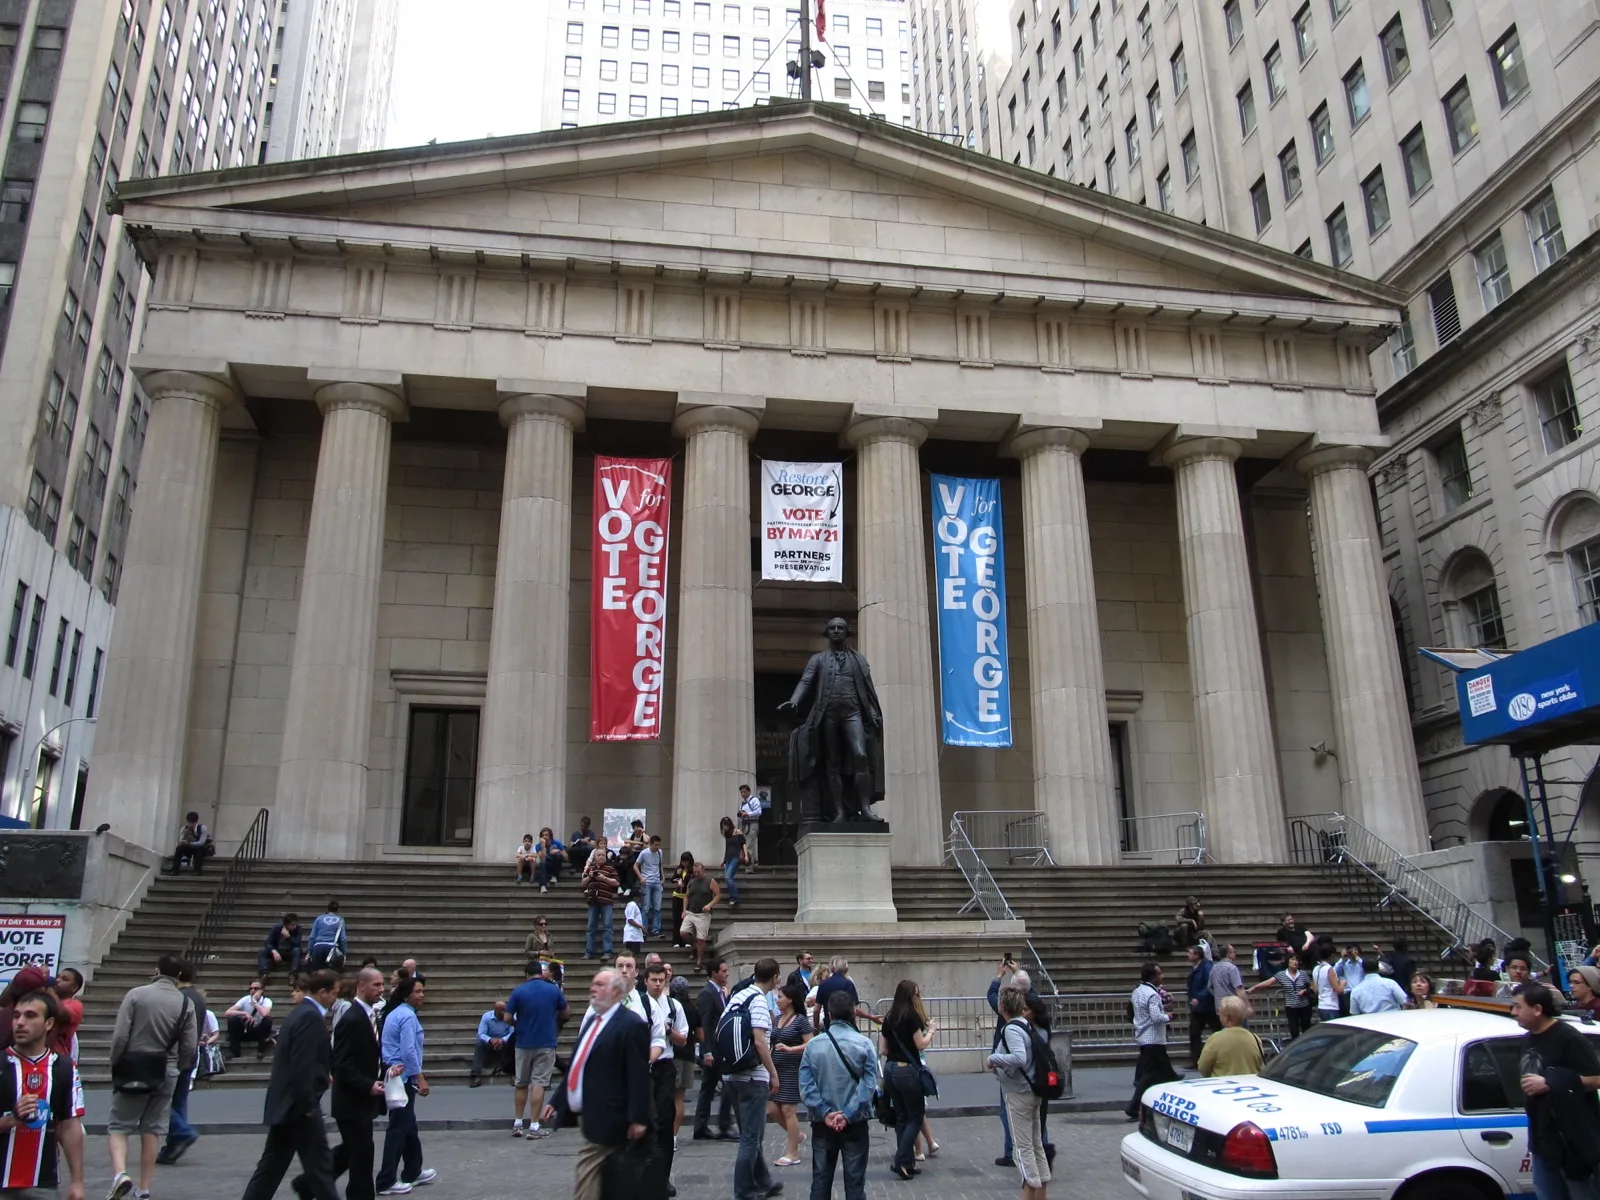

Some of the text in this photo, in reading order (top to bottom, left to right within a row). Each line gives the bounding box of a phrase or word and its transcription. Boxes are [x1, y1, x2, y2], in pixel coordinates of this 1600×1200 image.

[777, 469, 829, 485] Restore
[771, 483, 835, 496] GEORGE
[782, 508, 824, 520] VOTE
[971, 496, 996, 516] for
[767, 527, 838, 542] BY MAY 21
[937, 483, 968, 610] VOTE
[774, 550, 831, 561] PARTNERS
[774, 564, 831, 572] PRESERVATION
[598, 477, 665, 727] VOTE for GEORGE
[969, 526, 1003, 722] GEORGE
[1541, 683, 1571, 699] new york
[1537, 691, 1578, 710] sports clubs
[0, 931, 44, 945] VOTE
[1160, 1092, 1196, 1111] NYPD
[1152, 1100, 1200, 1126] POLICE
[1320, 1121, 1342, 1135] FSD
